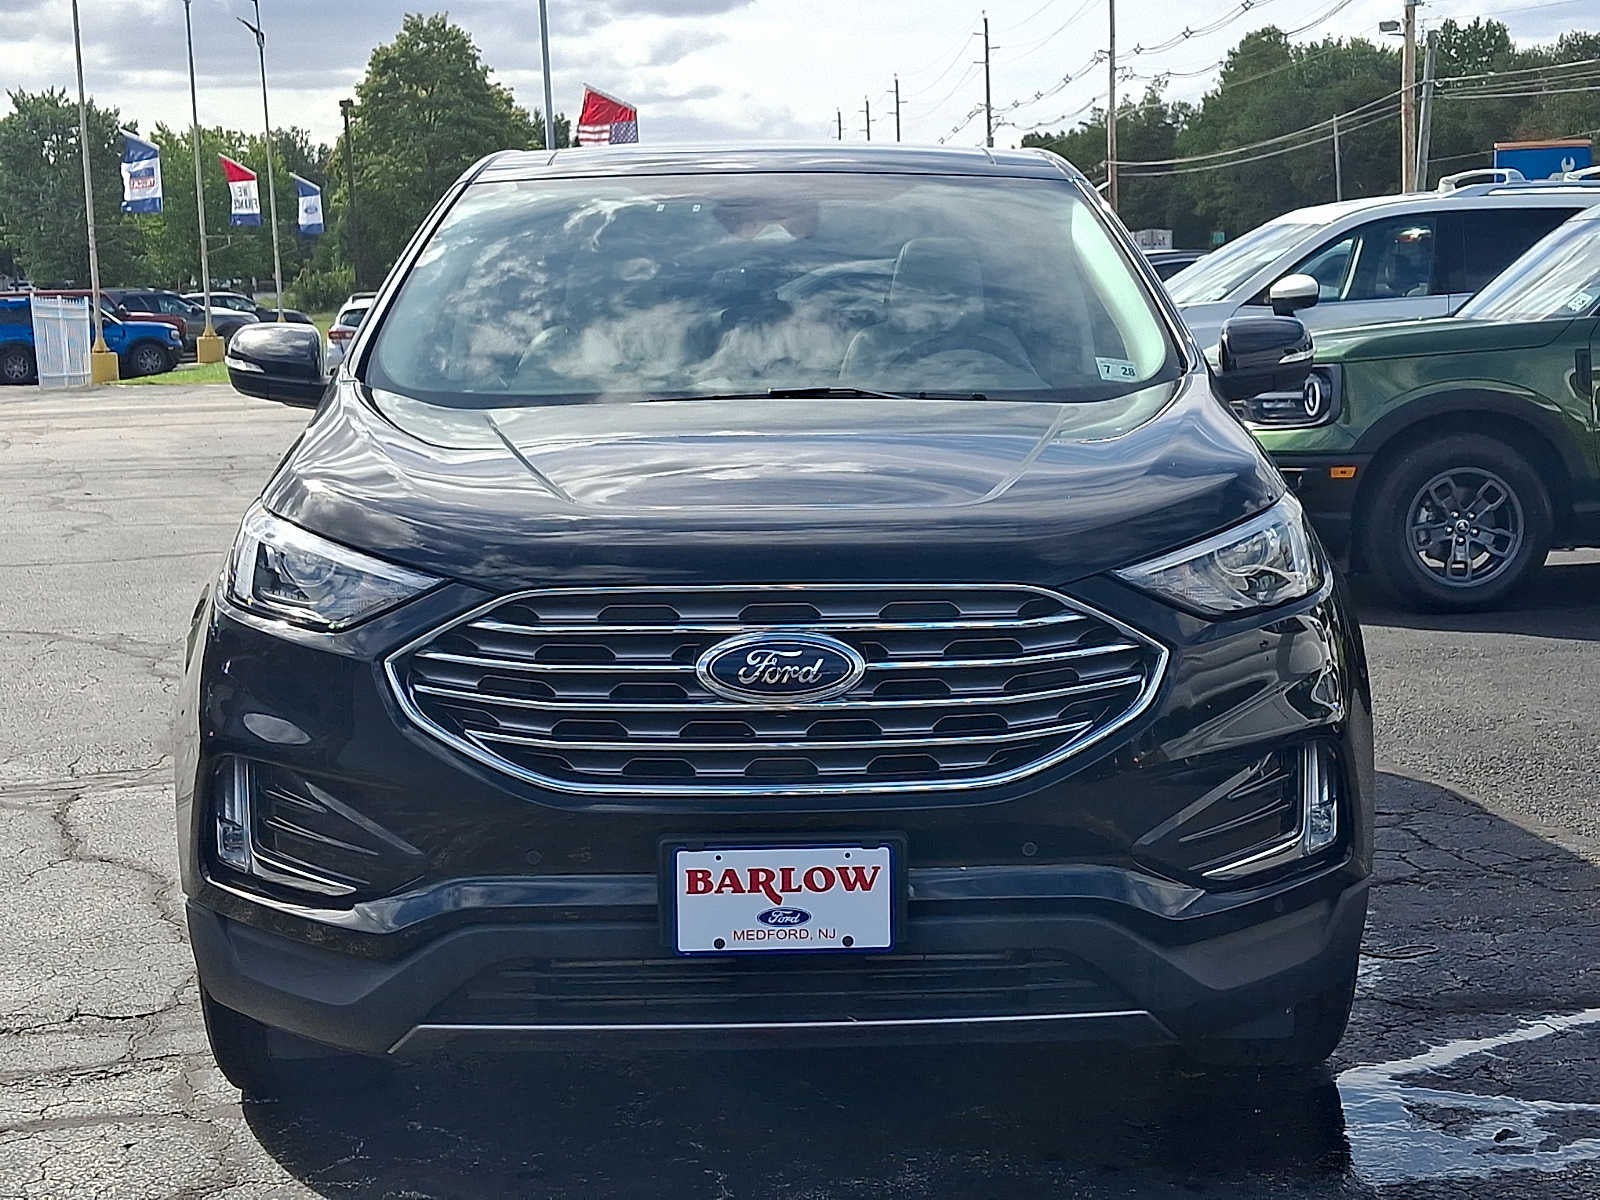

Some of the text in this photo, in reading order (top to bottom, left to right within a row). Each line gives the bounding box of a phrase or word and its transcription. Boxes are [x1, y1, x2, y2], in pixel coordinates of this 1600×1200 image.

[1103, 364, 1136, 377] 7 28
[737, 649, 825, 685] Ford
[685, 865, 881, 906] BARLOW
[768, 910, 801, 924] Ford
[733, 927, 837, 941] MEDFORD, NJ
